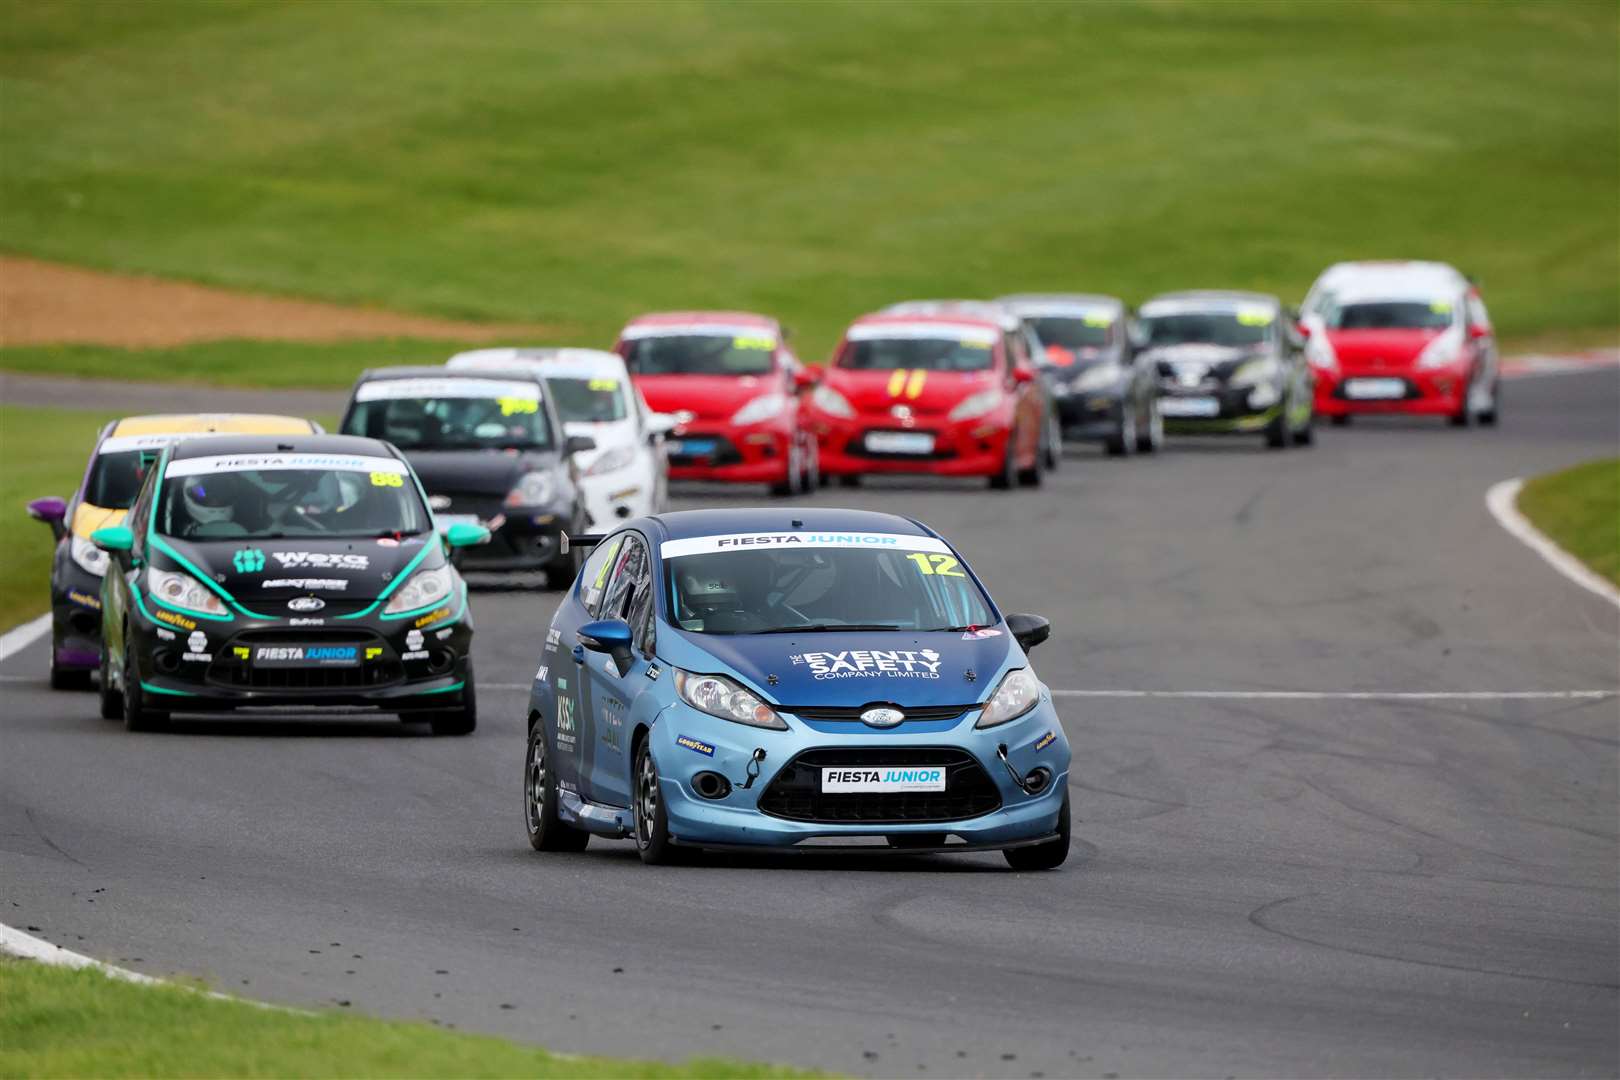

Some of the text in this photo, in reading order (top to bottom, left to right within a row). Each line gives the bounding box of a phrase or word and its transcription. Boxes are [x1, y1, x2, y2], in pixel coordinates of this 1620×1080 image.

[215, 457, 364, 468] FIESTA JUNIOR
[718, 535, 897, 547] FIESTA JUNIOR
[906, 553, 965, 578] 12
[257, 647, 304, 659] FIESTA
[304, 647, 357, 659] JUNIOR
[803, 650, 918, 664] EVENT
[809, 660, 942, 674] SAFETY
[814, 670, 940, 680] COMPANY LIMITED
[678, 737, 713, 754] GOODYEAR
[828, 770, 941, 783] FIESTA JUNIOR
